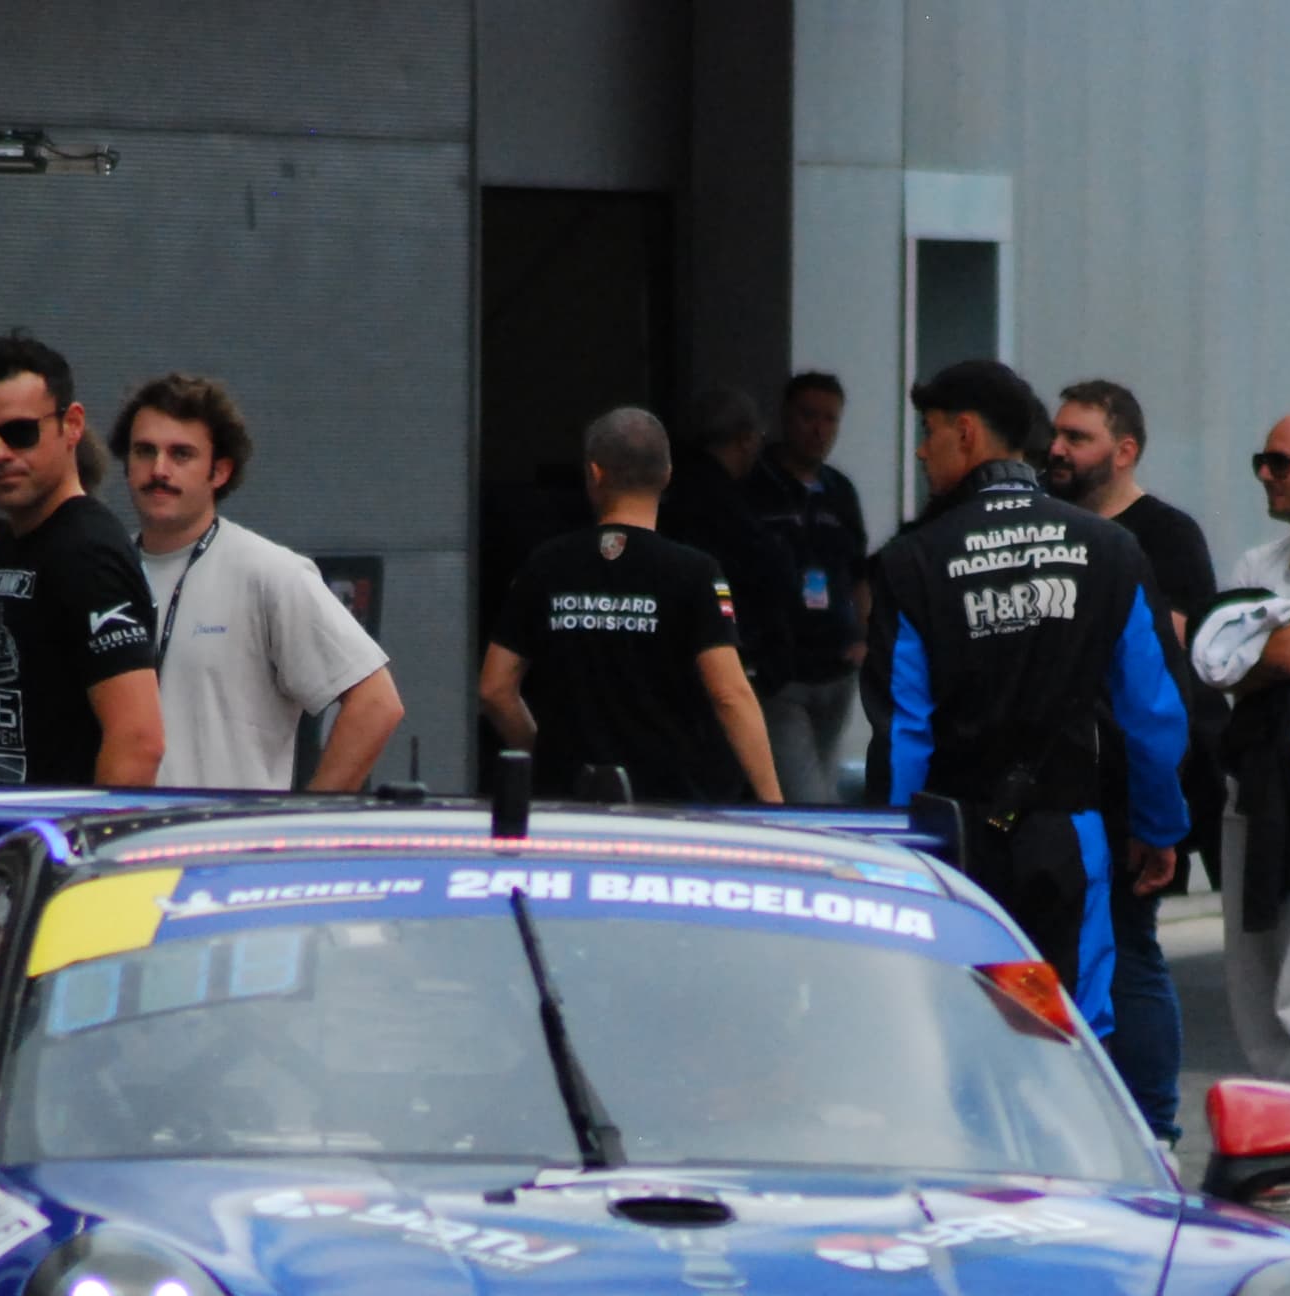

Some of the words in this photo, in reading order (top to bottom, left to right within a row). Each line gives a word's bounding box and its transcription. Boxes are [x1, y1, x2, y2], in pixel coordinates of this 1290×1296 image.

[948, 546, 1088, 578] motorsport
[553, 597, 657, 613] HOLMGAARD
[963, 584, 1036, 631] H&R
[552, 615, 658, 632] MOTORSPORT
[227, 879, 424, 904] MICHELIN
[446, 870, 572, 899] 24H
[589, 872, 936, 940] BARCELONA
